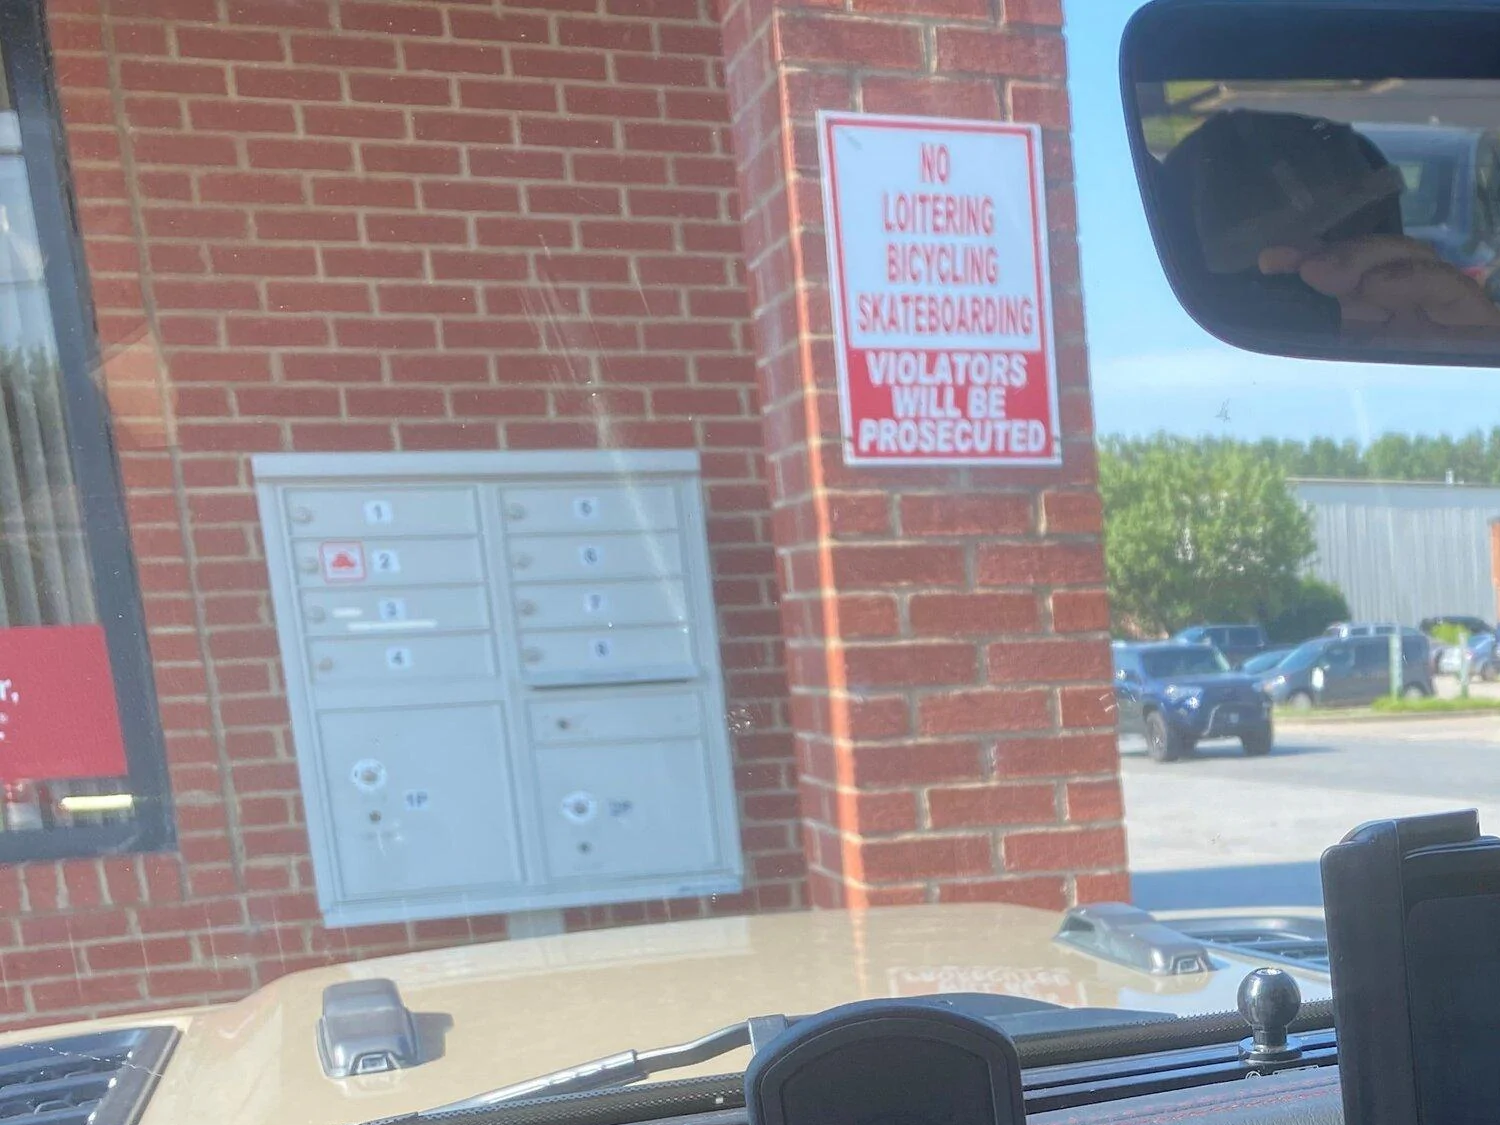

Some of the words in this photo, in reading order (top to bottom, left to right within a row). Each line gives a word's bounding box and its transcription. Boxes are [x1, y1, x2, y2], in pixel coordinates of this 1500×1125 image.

[919, 142, 951, 183] NO
[882, 192, 994, 236] LOITERING
[886, 243, 999, 285] BICYCLING
[858, 295, 1033, 335] SKATEBOARDING
[865, 352, 1027, 387] VIOLATORS
[892, 385, 960, 419] WILL
[966, 386, 1006, 419] BE
[858, 419, 1047, 453] PROSECUTED
